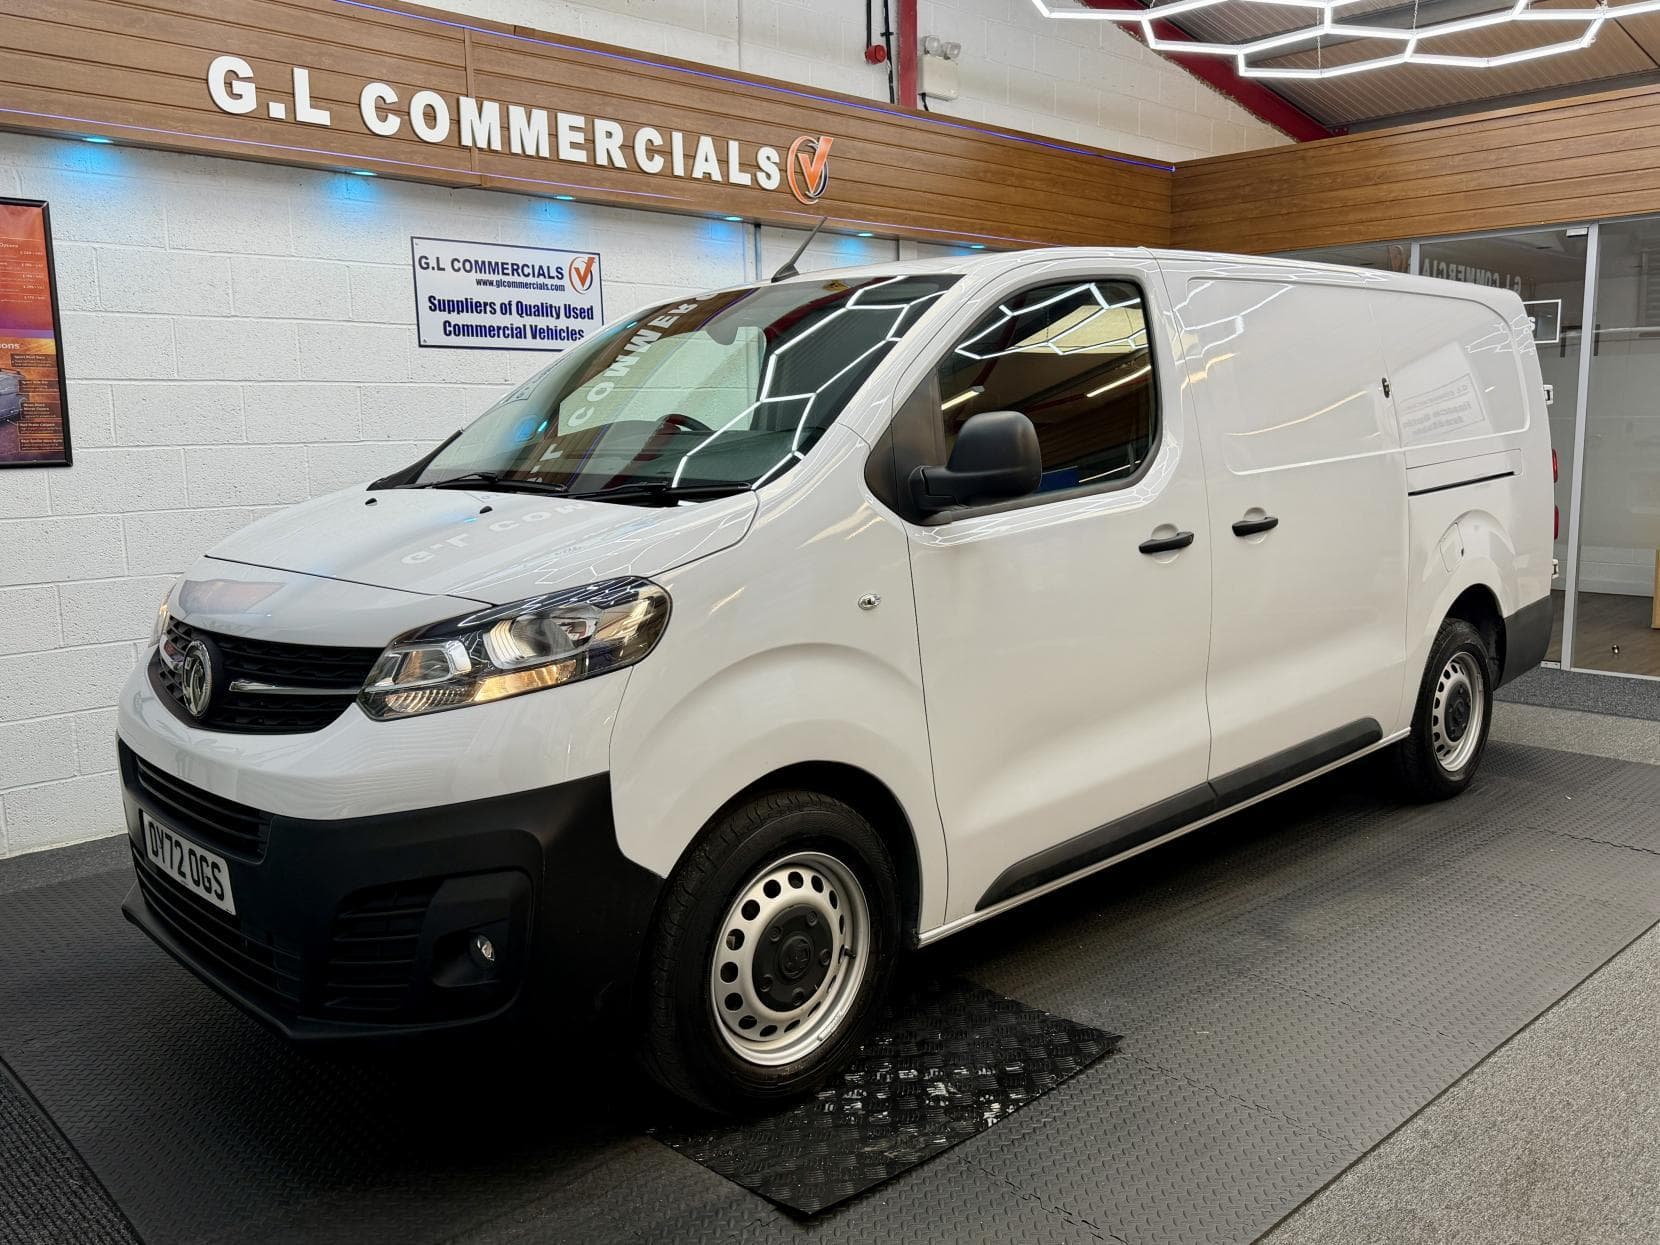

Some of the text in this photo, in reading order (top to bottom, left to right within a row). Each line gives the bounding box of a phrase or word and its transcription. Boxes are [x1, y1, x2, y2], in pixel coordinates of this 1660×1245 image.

[208, 56, 781, 190] G.L COMMERCIALS
[418, 255, 565, 281] G.L COMMERCIALS
[475, 278, 566, 292] www.glcommercials.com
[428, 295, 594, 320] Suppliers of Quality Used
[443, 320, 585, 342] Commercial Vehicles
[188, 848, 224, 902] OGS
